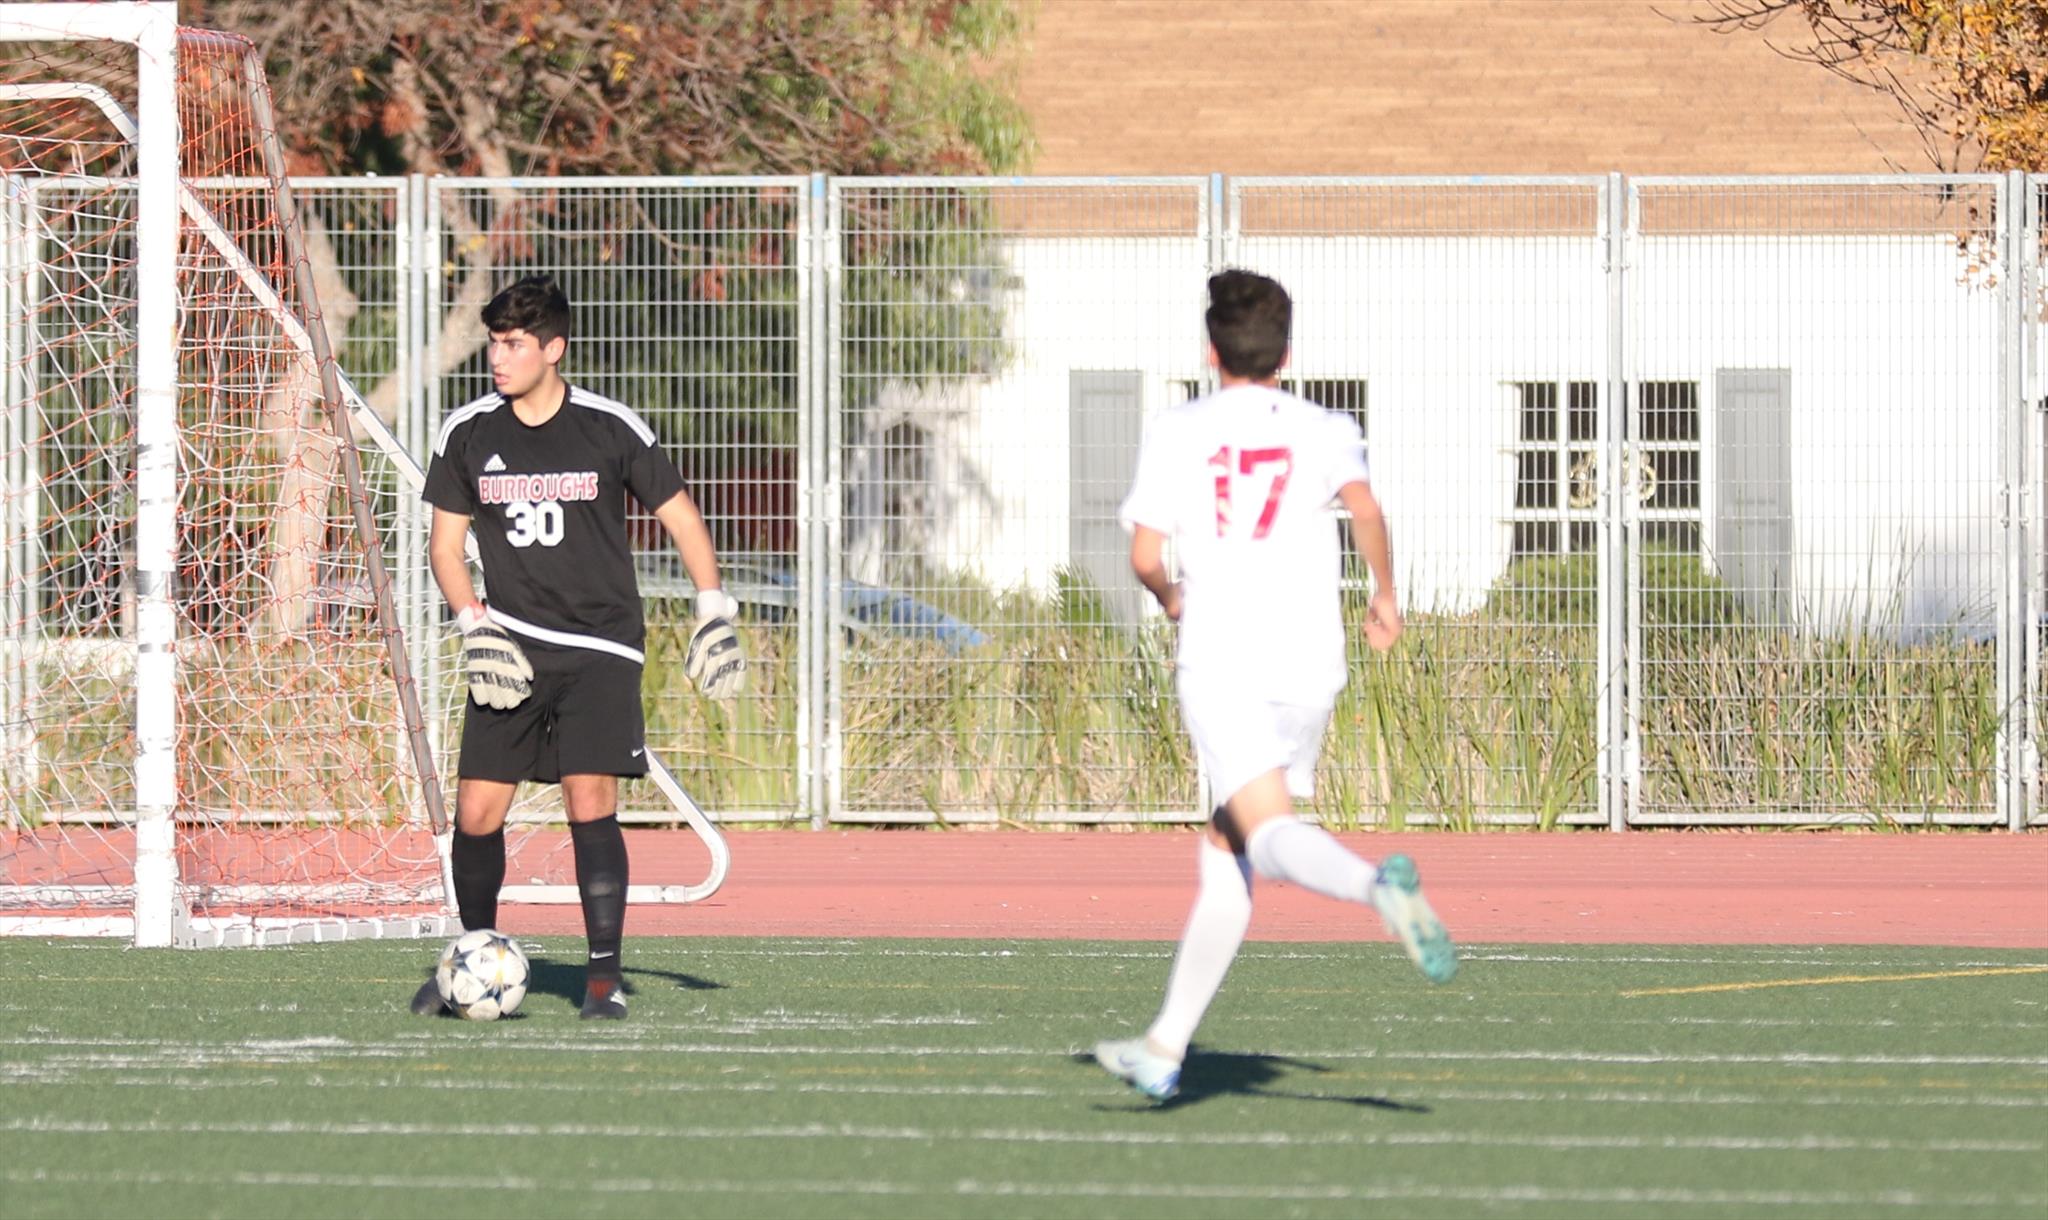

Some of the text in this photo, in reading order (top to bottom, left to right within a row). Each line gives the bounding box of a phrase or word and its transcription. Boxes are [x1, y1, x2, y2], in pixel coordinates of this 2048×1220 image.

[478, 471, 599, 504] BURROUGHS
[1208, 446, 1293, 539] 17
[505, 501, 564, 548] 30
